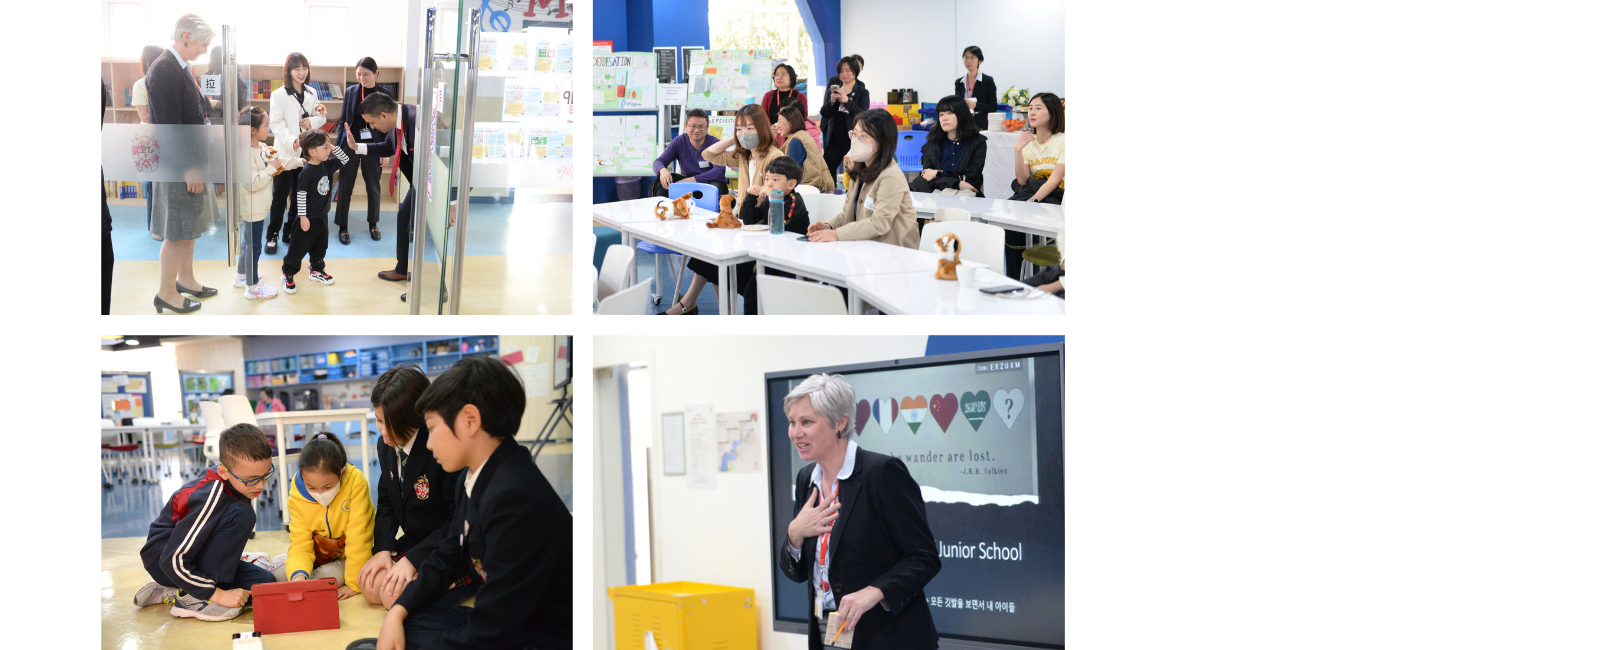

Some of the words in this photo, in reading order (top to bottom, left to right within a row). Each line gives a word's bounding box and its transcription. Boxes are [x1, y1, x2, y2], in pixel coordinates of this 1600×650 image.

[206, 78, 215, 89] 拉
[1029, 157, 1058, 168] GANNI
[990, 361, 1021, 371] EXZUXM
[905, 450, 943, 463] wander
[947, 452, 965, 462] are
[969, 449, 995, 462] lost.
[938, 540, 976, 559] Junior
[978, 541, 1022, 561] School
[931, 596, 943, 607] 모든
[965, 599, 985, 611] 보면서
[986, 600, 993, 611] 내
[995, 601, 1015, 613] 아이들
